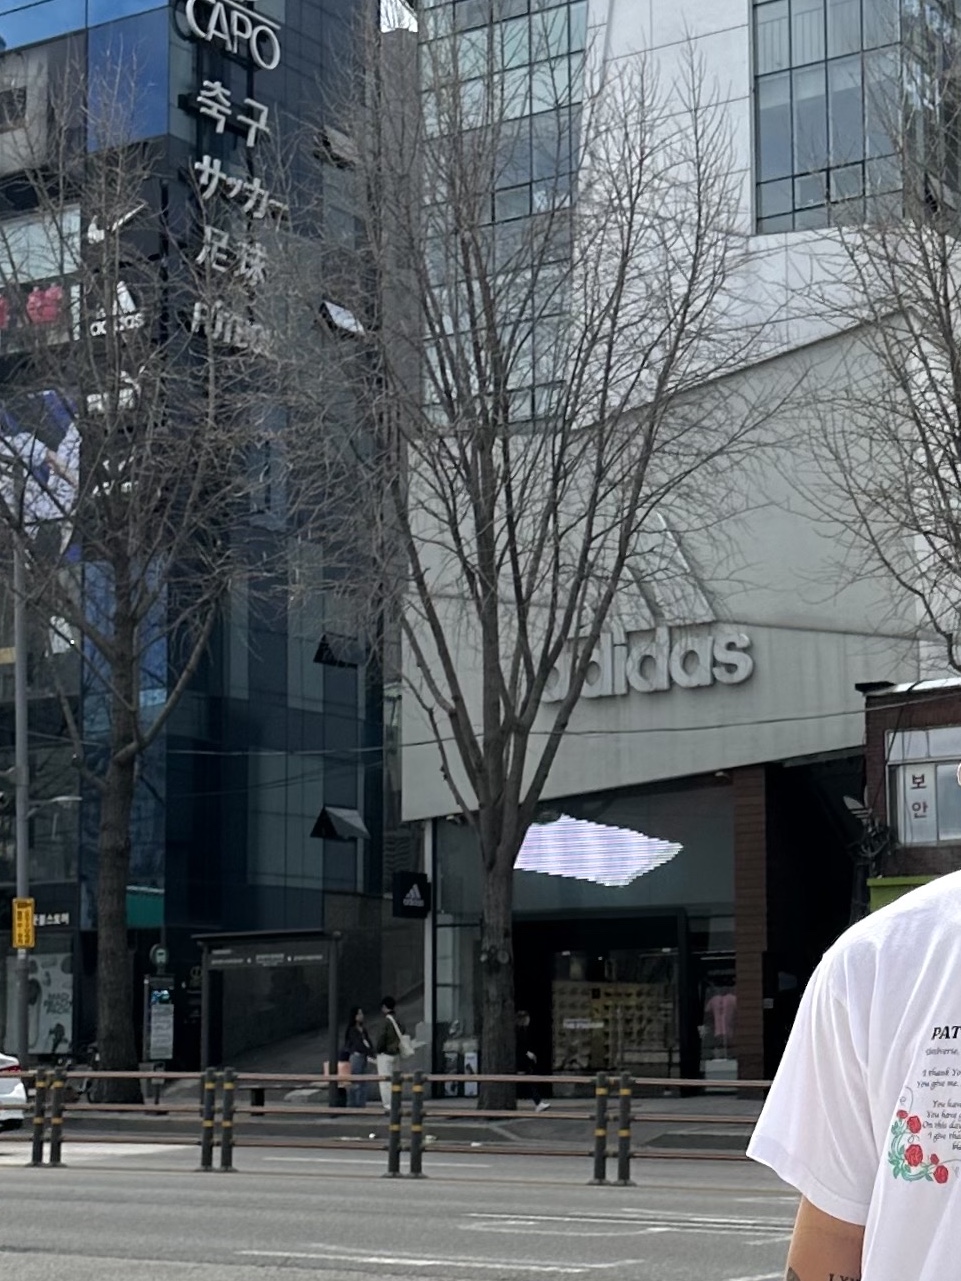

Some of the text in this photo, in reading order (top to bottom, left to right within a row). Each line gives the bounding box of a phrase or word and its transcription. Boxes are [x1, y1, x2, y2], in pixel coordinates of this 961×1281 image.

[185, 0, 281, 70] CAPO
[197, 80, 270, 147] 축구
[194, 154, 289, 219] サッカー
[911, 774, 928, 819] 보안
[928, 1067, 950, 1077] thank
